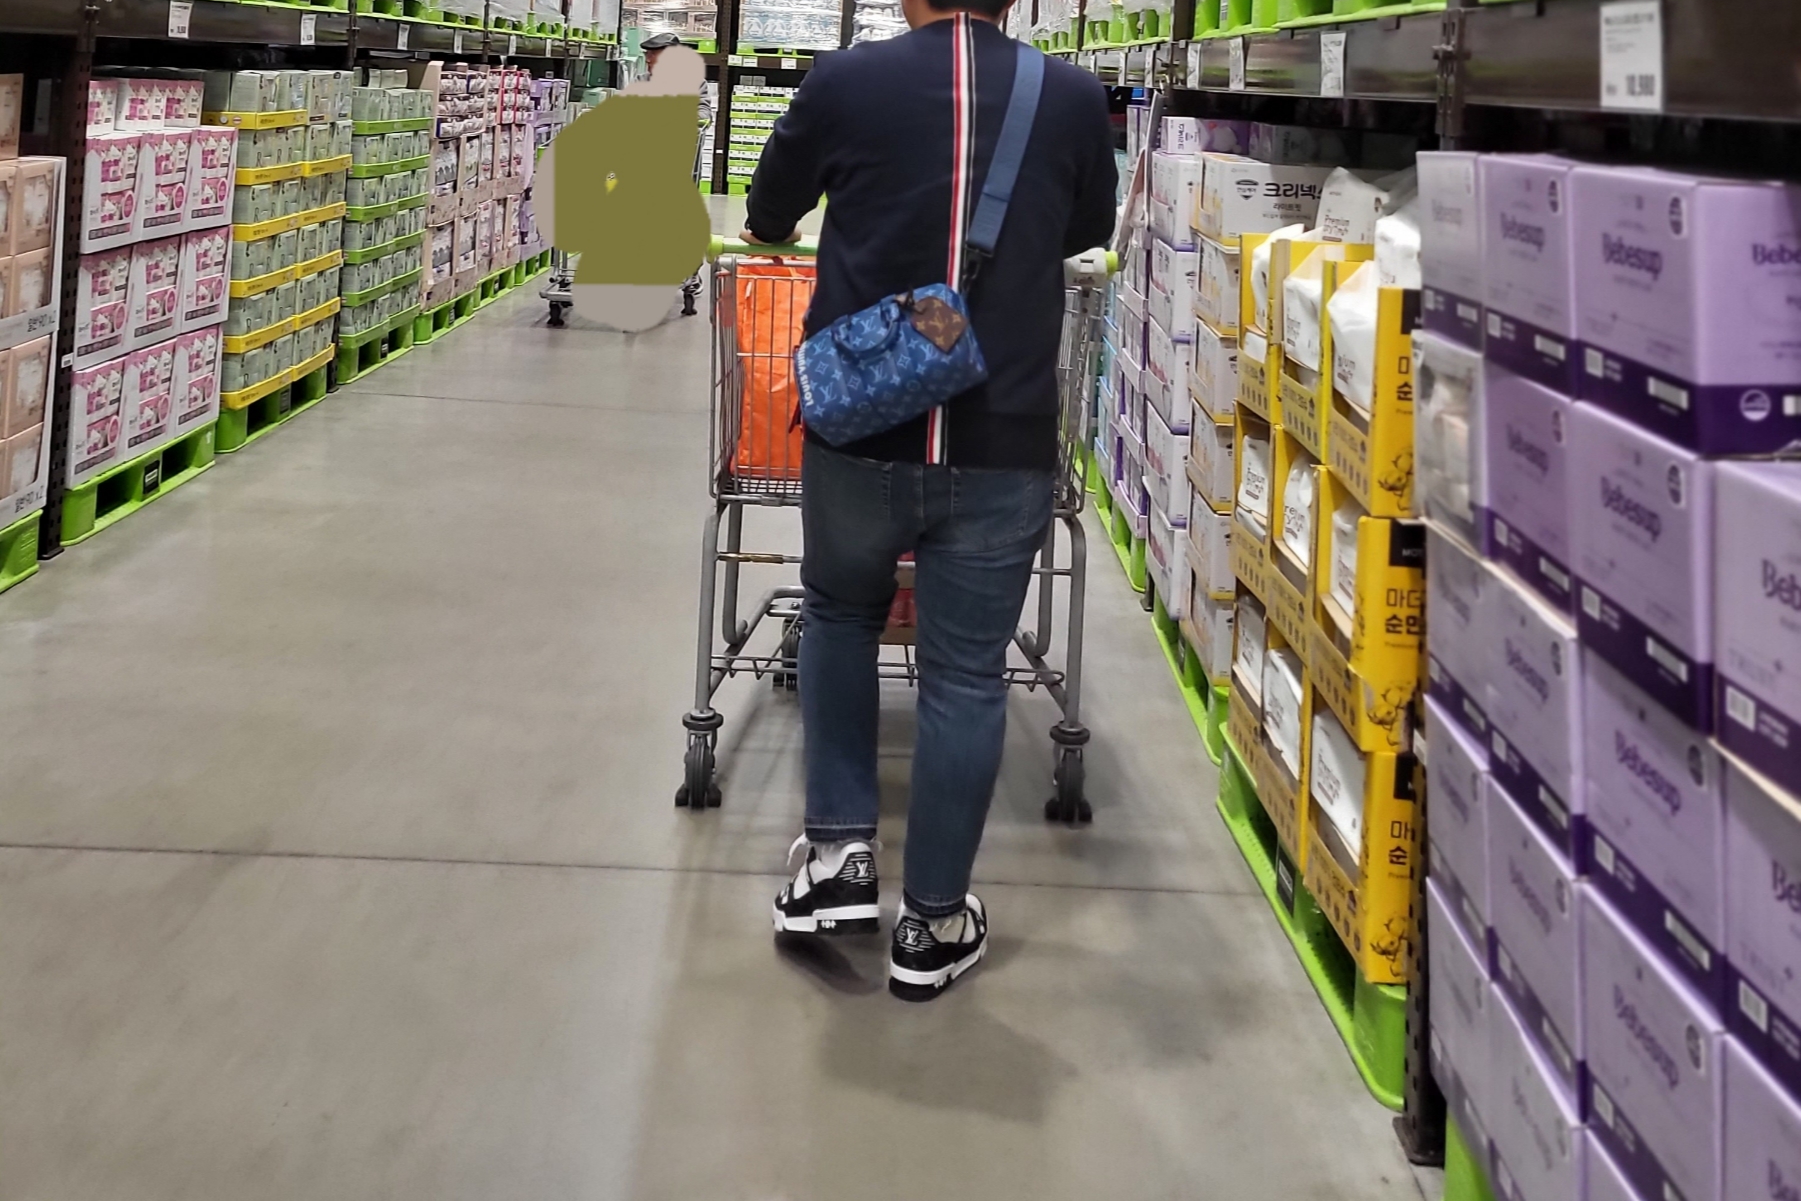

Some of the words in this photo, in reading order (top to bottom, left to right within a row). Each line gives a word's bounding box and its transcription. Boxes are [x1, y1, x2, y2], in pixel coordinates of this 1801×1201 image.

[1602, 232, 1663, 282] Bebesup
[800, 374, 815, 407] LOUIS
[1601, 475, 1662, 544] Bebesup
[1615, 729, 1682, 817] Bebesup
